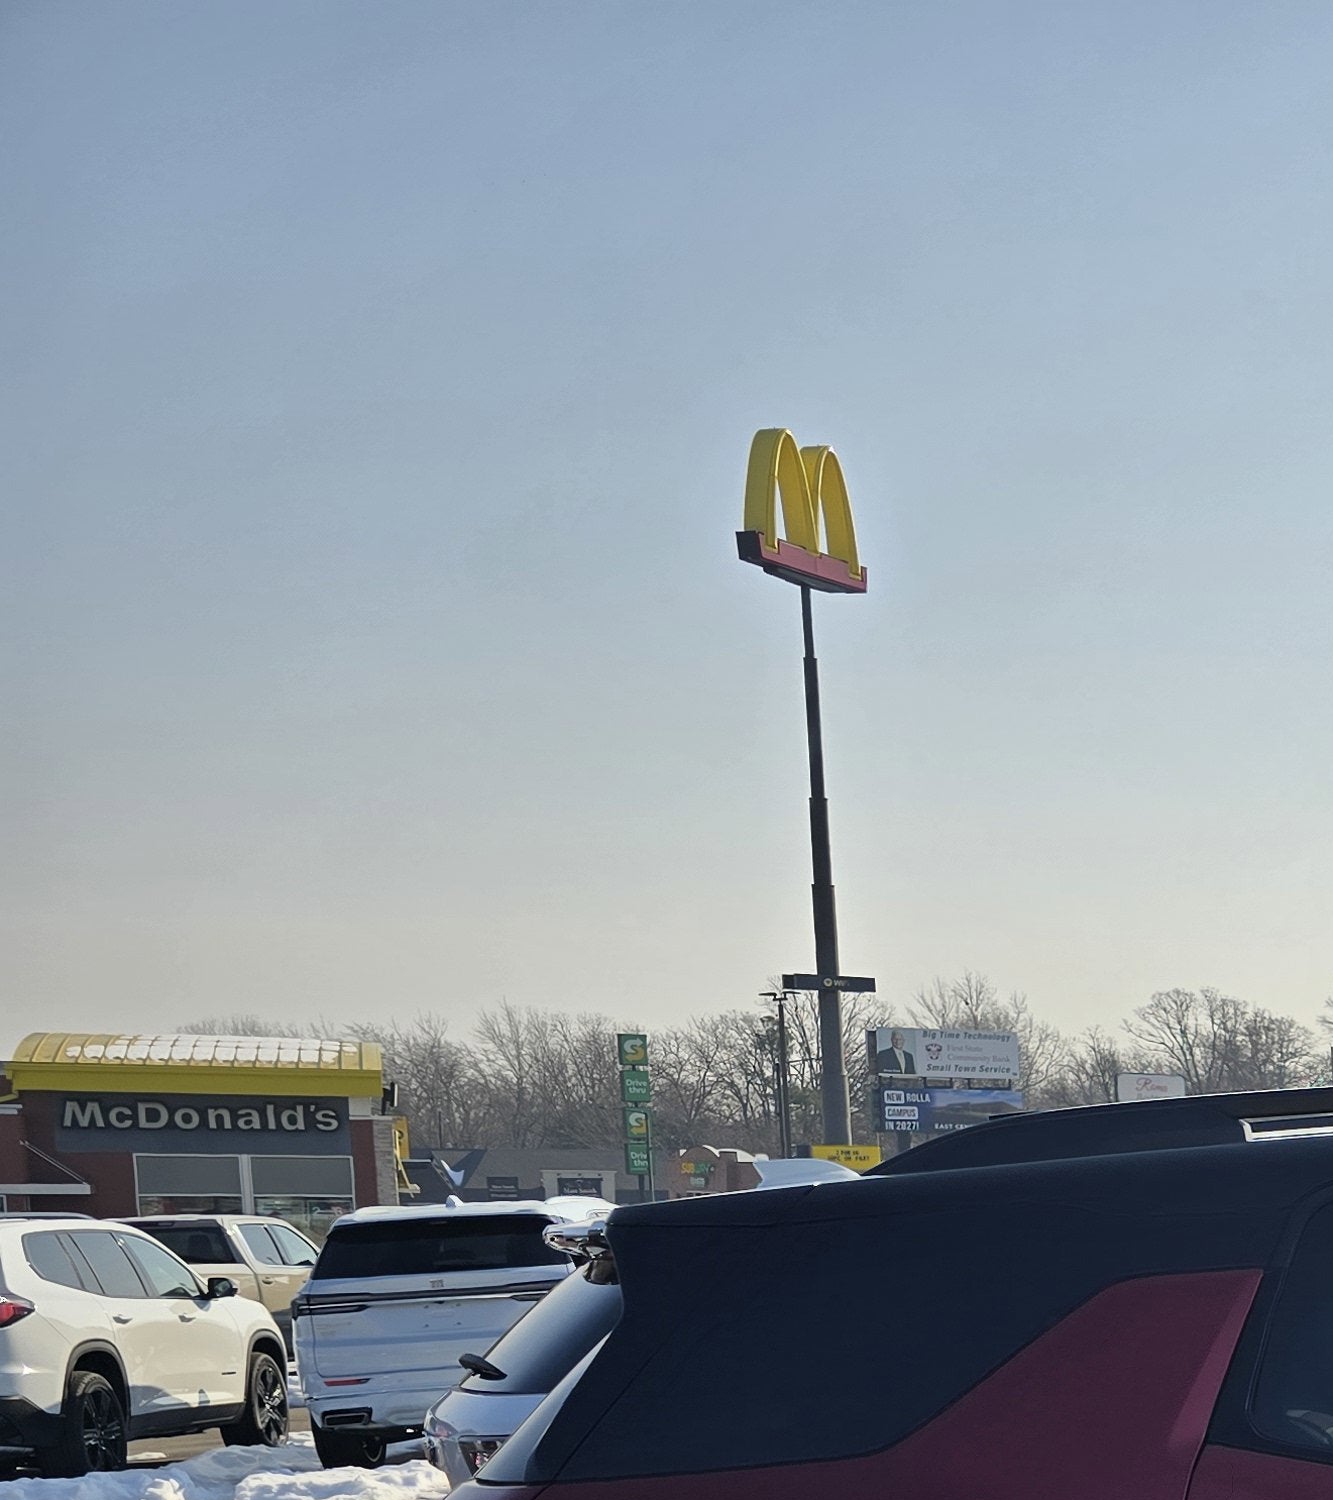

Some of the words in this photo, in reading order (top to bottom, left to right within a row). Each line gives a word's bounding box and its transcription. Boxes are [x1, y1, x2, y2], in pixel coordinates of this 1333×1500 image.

[922, 1030, 936, 1040] Big
[940, 1031, 960, 1039] Time
[964, 1031, 1011, 1043] Technology
[926, 1063, 951, 1072] Small
[954, 1064, 977, 1073] Town
[979, 1065, 1011, 1074] Service
[626, 1078, 647, 1087] Drive
[629, 1086, 646, 1094] thru
[886, 1093, 903, 1102] NEW
[906, 1093, 931, 1103] ROLLA
[62, 1100, 340, 1131] McDonald's
[887, 1108, 917, 1117] CAMPUS
[885, 1121, 894, 1130] IN
